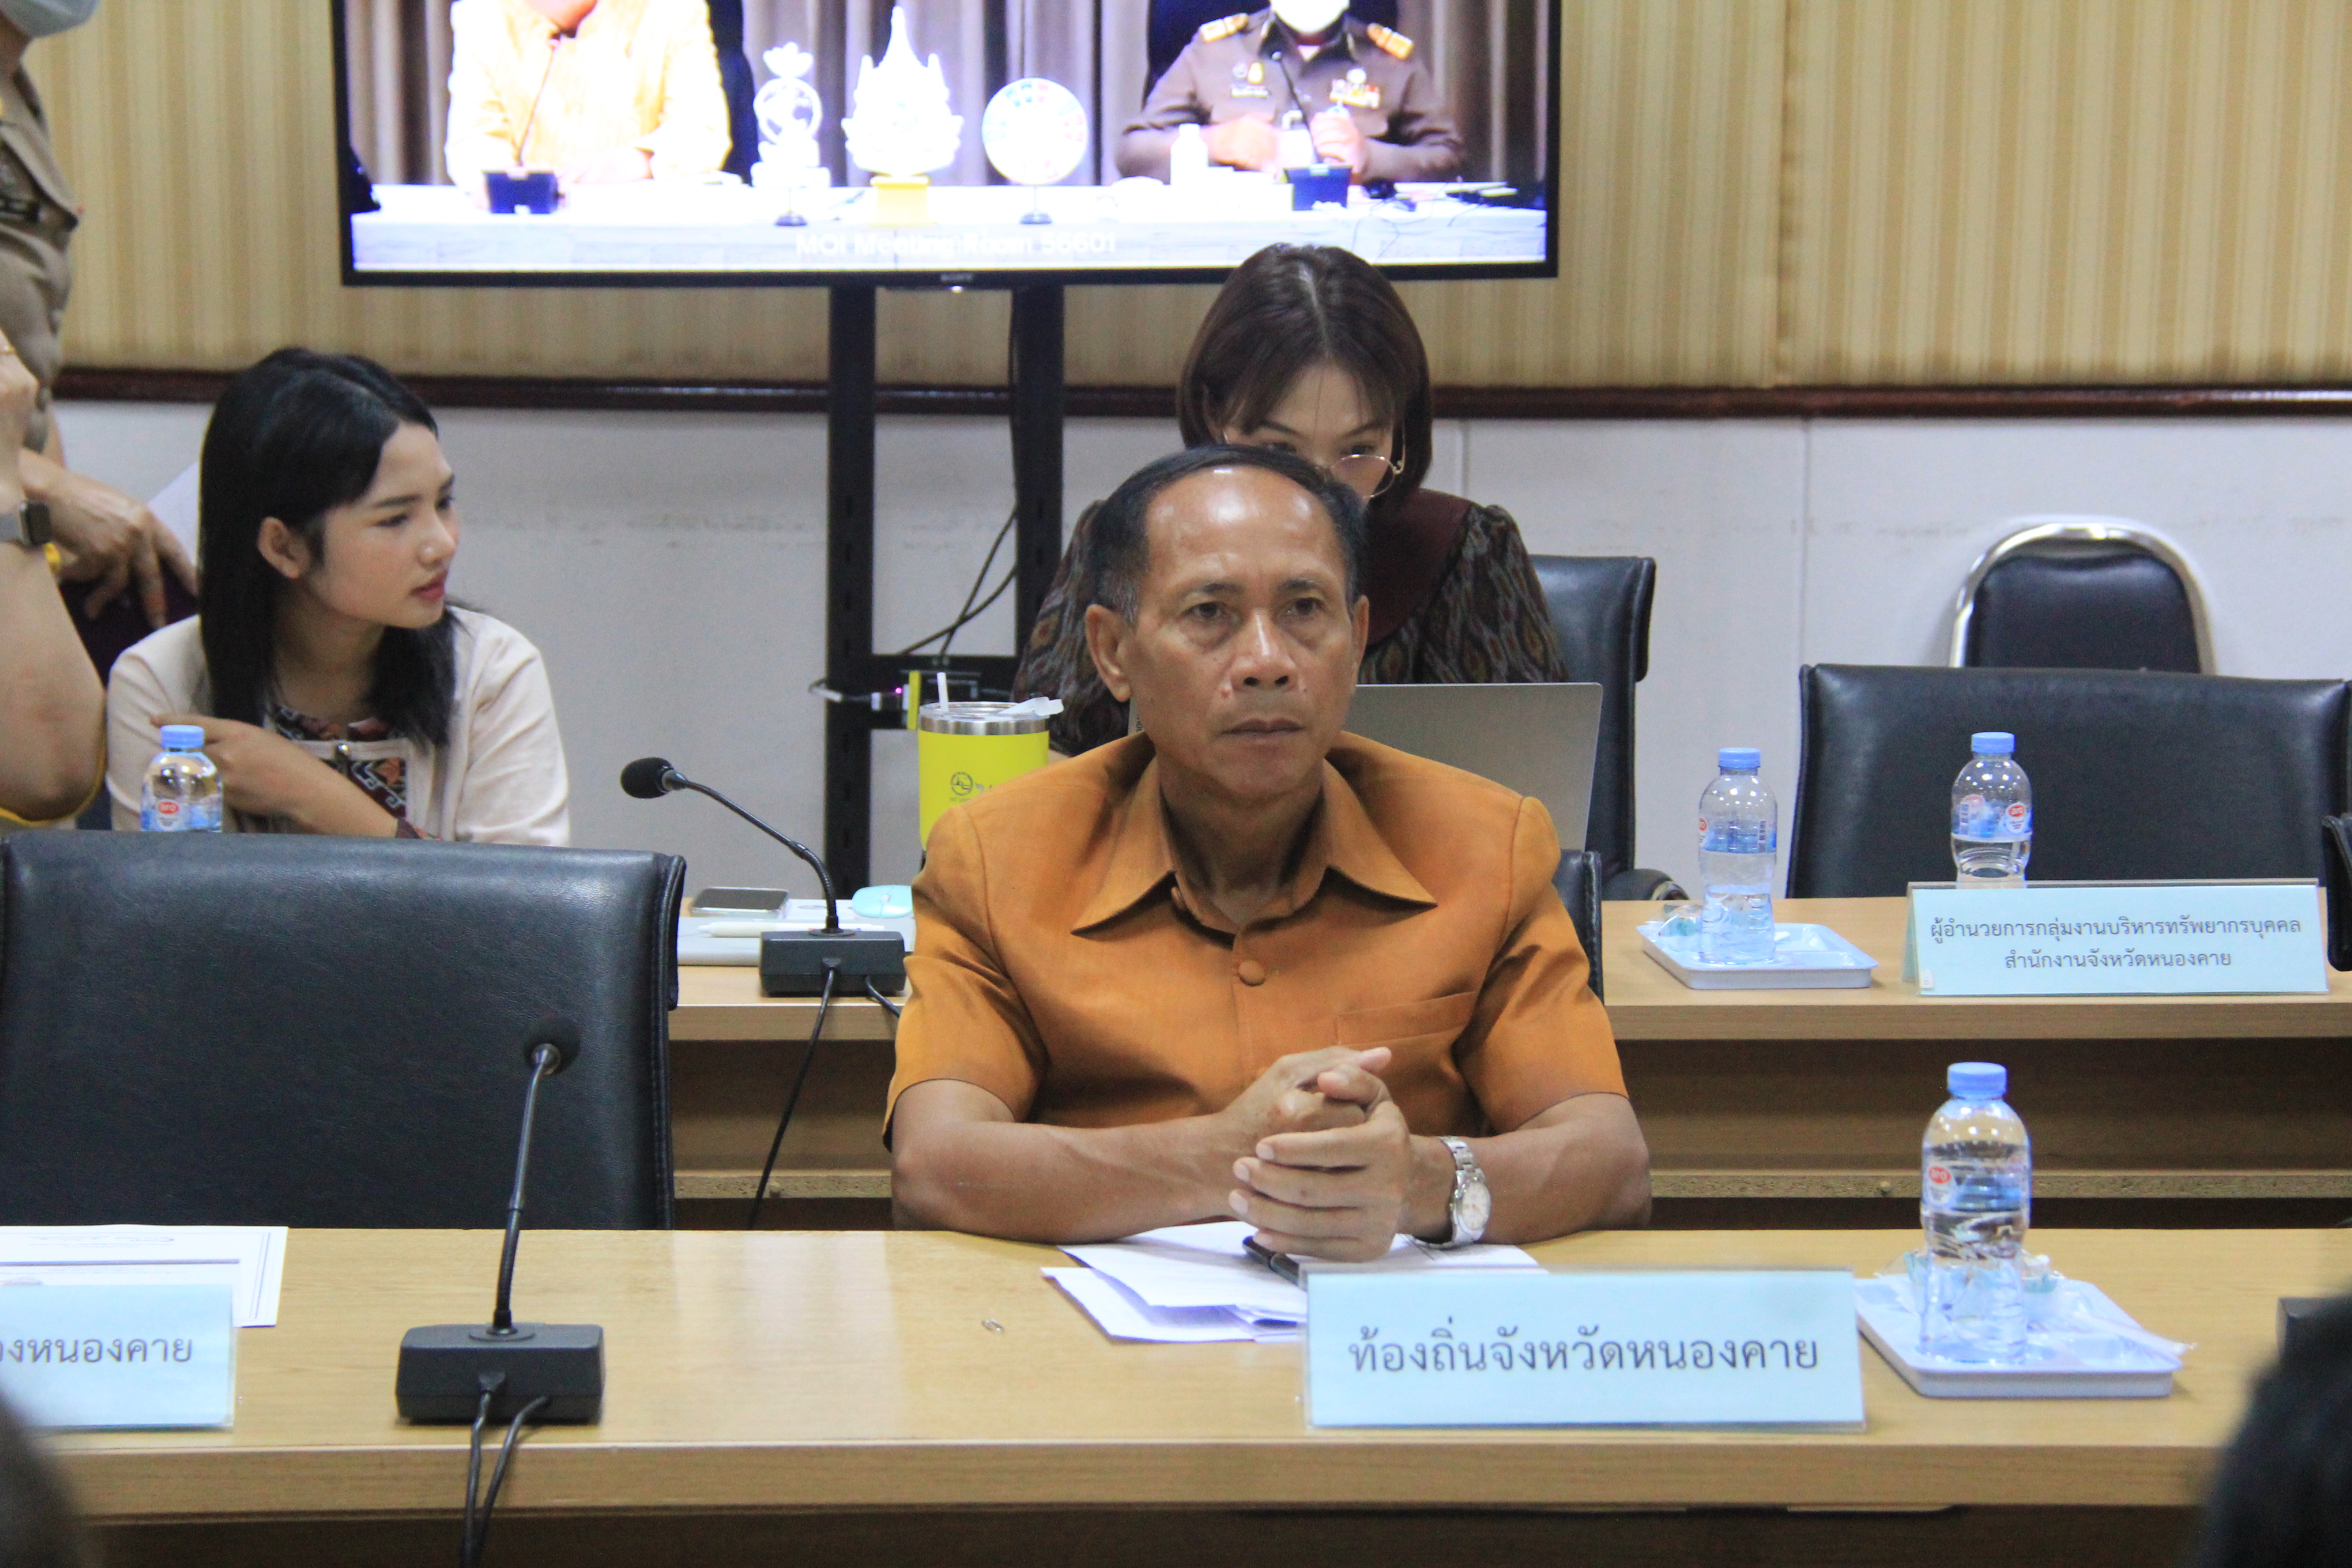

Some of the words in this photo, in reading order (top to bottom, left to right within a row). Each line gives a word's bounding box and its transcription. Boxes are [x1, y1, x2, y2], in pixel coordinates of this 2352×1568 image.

[963, 233, 1032, 254] Room
[1041, 232, 1116, 253] 56601
[1931, 915, 2302, 944] ผู้อำนวยการกลุ่มงานบริหารทรัพยากรบุคคล
[2005, 947, 2232, 968] สำนักงานจังหวัดหนองคาย
[1348, 1316, 1818, 1372] ท้องถิ่นจังหวัดหนองคาย
